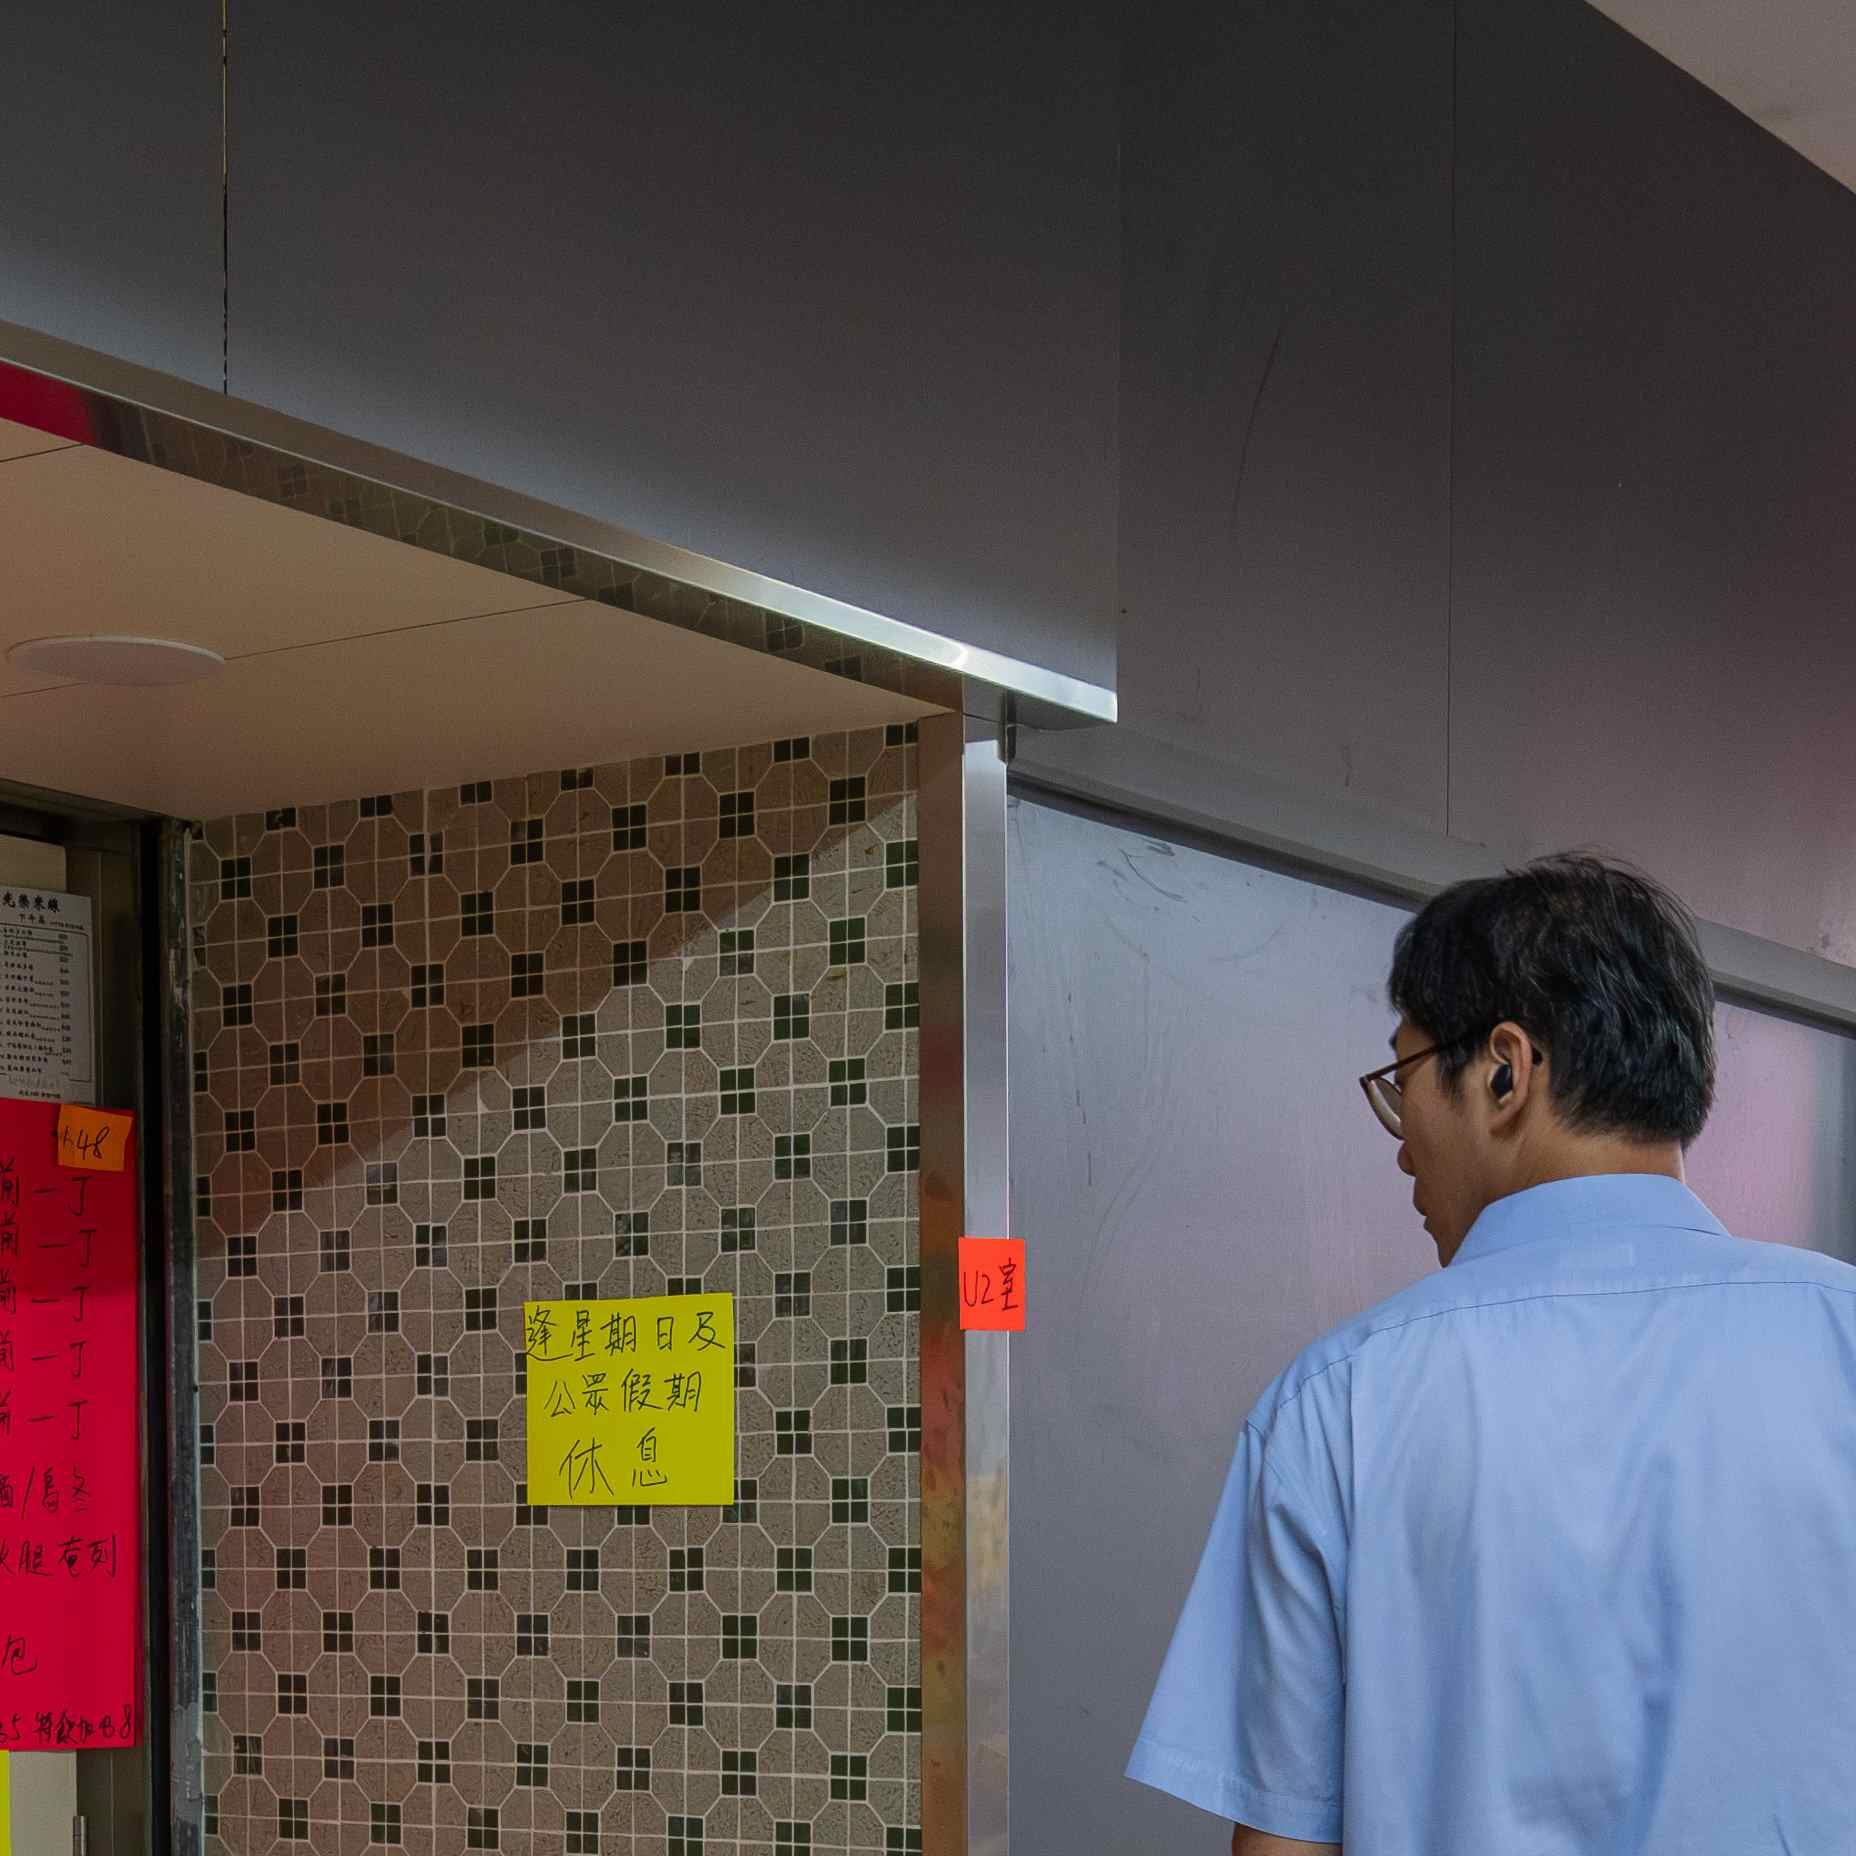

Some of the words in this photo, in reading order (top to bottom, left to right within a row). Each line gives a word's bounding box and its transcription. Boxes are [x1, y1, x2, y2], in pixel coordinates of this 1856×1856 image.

[524, 1306, 726, 1362] 逢星期日及
[544, 1369, 702, 1418] 公眾假期
[560, 1427, 668, 1499] 休息
